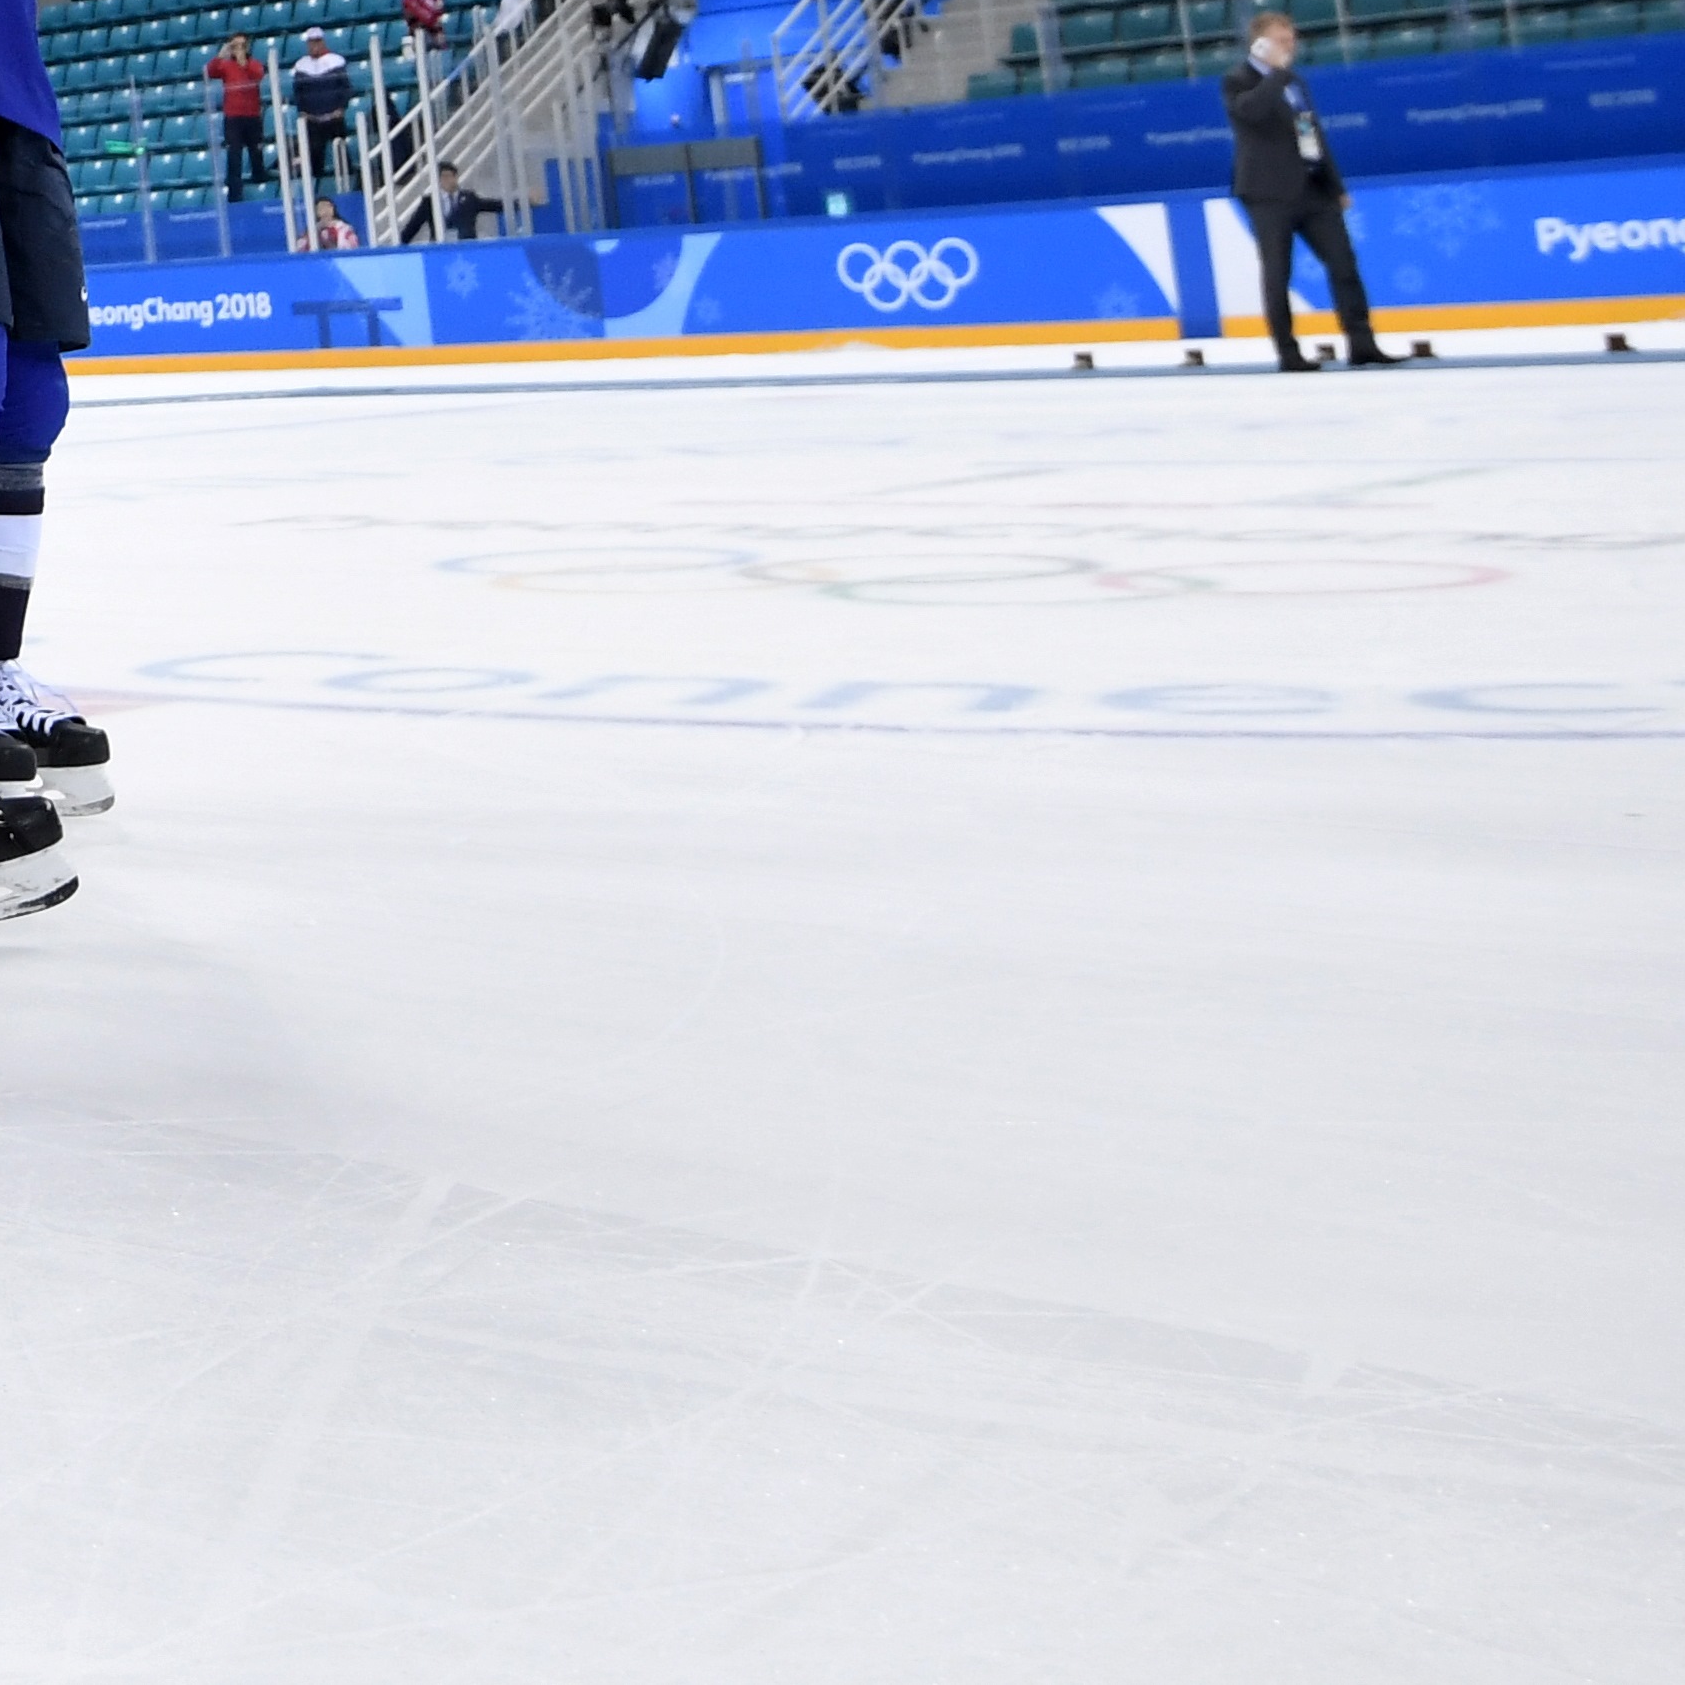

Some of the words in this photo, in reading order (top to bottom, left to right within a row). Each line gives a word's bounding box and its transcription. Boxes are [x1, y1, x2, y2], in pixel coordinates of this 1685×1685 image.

[1534, 216, 1685, 262] Pyeon
[214, 291, 273, 319] 2018
[136, 649, 1685, 716] Connec
